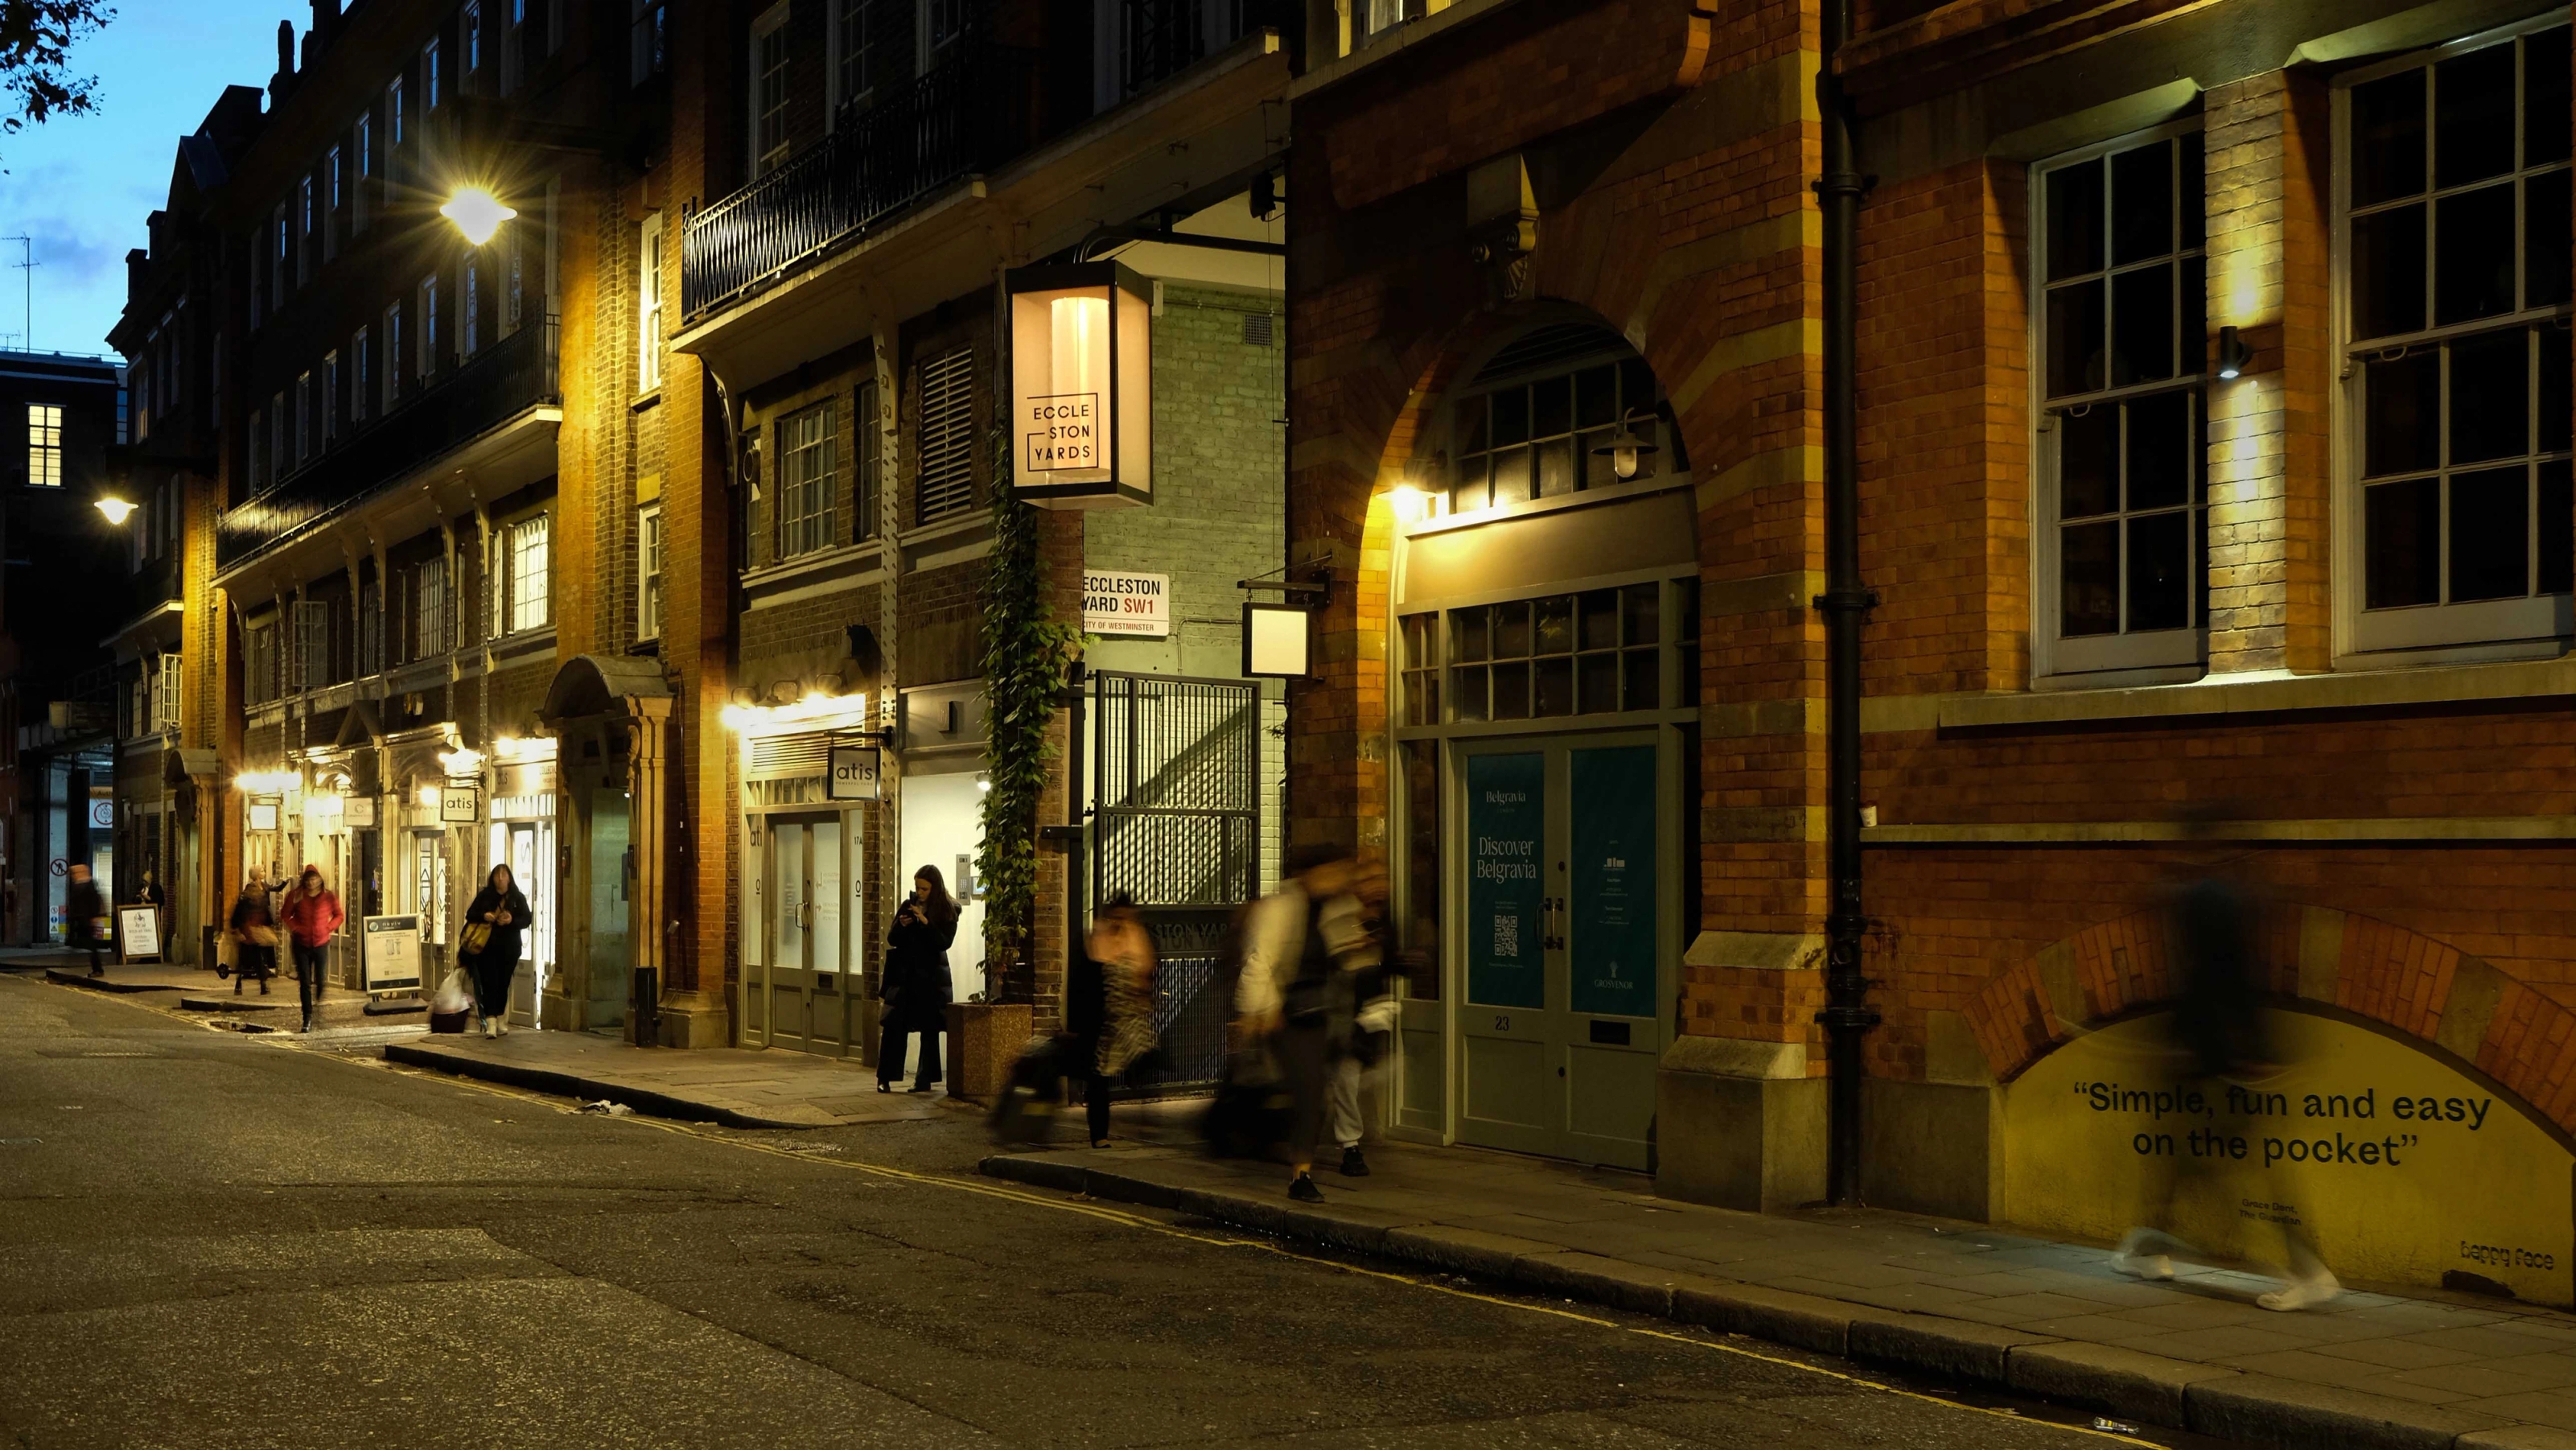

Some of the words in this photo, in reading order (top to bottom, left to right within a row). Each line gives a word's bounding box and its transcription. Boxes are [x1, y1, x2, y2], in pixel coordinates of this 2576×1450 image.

[1034, 405, 1088, 420] ECCLE
[1049, 425, 1089, 439] STON
[1035, 445, 1090, 461] YARDS
[1083, 576, 1160, 595] ECCLESTON
[1082, 596, 1118, 612] YARD
[1124, 598, 1154, 614] SW1
[1098, 621, 1106, 629] OF
[1109, 622, 1154, 632] WESTMINSTER
[837, 763, 873, 781] atis
[446, 797, 472, 809] atis
[1486, 790, 1526, 805] Belgravia
[750, 826, 762, 847] ati
[1479, 837, 1534, 856] Discover
[1477, 859, 1537, 884] Belgravia
[1154, 924, 1195, 938] STON
[1594, 979, 1633, 990] GROSVENOR
[1496, 1015, 1509, 1031] 23
[2074, 1081, 2214, 1120] “Simple,
[2228, 1086, 2287, 1116] fun
[2303, 1089, 2376, 1118] and
[2393, 1094, 2492, 1131] easy
[2133, 1133, 2174, 1155] on
[2187, 1129, 2248, 1159] the
[2264, 1133, 2418, 1168] pocket”
[2242, 1198, 2269, 1209] Grace
[2272, 1202, 2298, 1214] Dent,
[2239, 1209, 2255, 1220] The
[2259, 1212, 2301, 1225] Guardian
[2515, 1248, 2554, 1271] face
